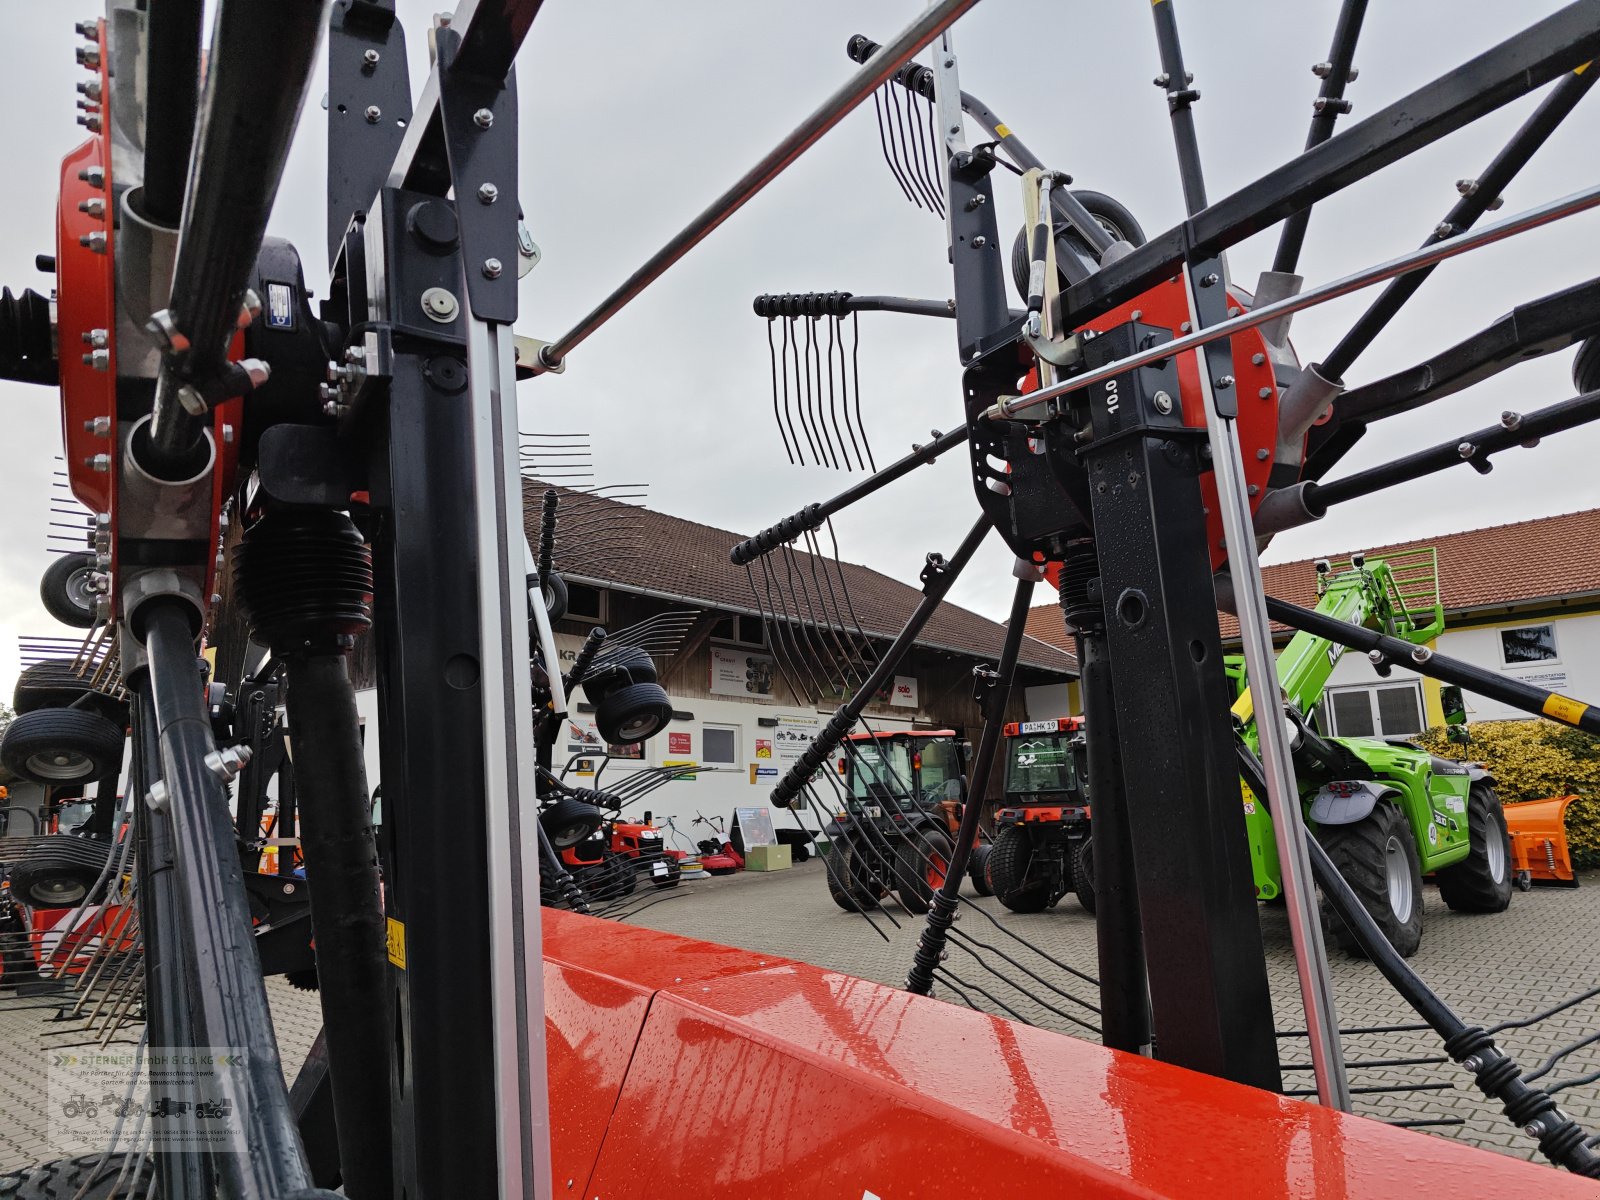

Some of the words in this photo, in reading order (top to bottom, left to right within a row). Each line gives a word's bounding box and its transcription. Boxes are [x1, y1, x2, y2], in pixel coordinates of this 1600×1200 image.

[559, 649, 577, 661] KR
[897, 684, 911, 694] solo
[1036, 723, 1046, 731] HK
[1047, 722, 1056, 730] 19
